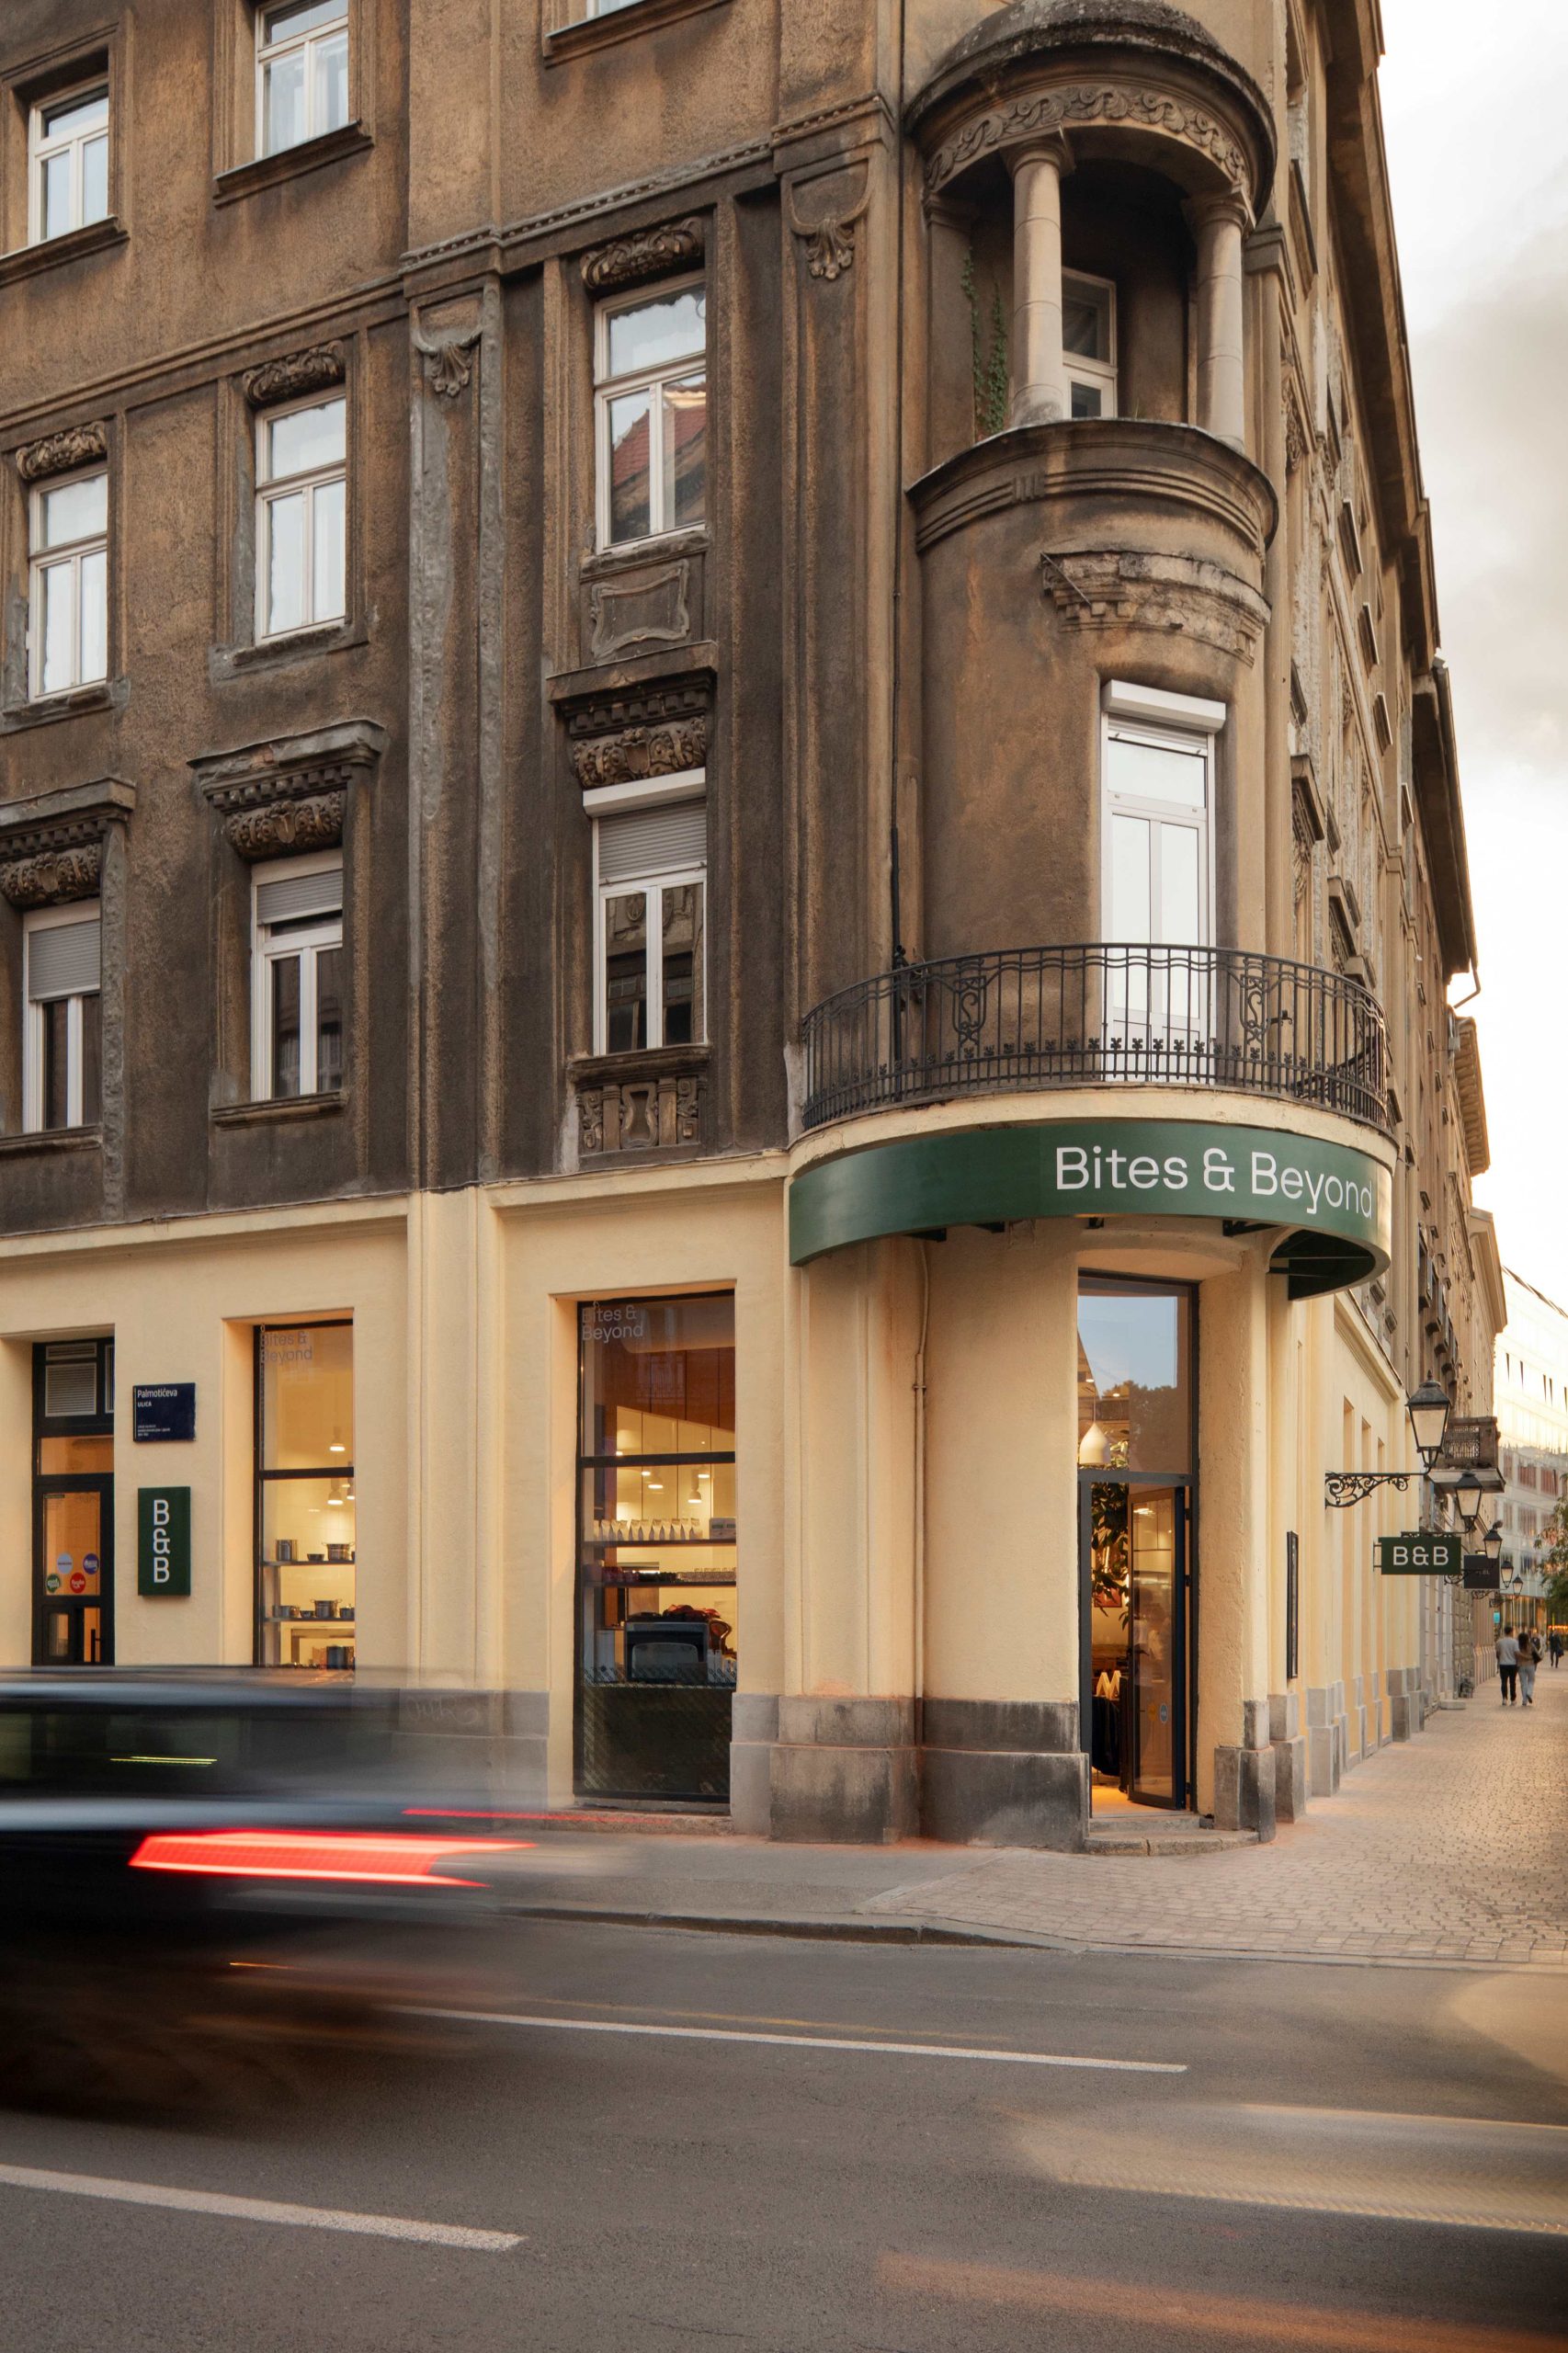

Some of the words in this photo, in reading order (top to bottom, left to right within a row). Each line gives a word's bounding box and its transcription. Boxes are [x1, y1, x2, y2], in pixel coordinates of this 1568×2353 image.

[1056, 1145, 1188, 1190] Bites
[1203, 1147, 1235, 1192] &
[1251, 1151, 1373, 1221] Beyond
[626, 1304, 637, 1321] &
[582, 1322, 643, 1344] Beyond
[137, 1387, 178, 1398] Palmotićeva
[1392, 1545, 1449, 1566] B&B
